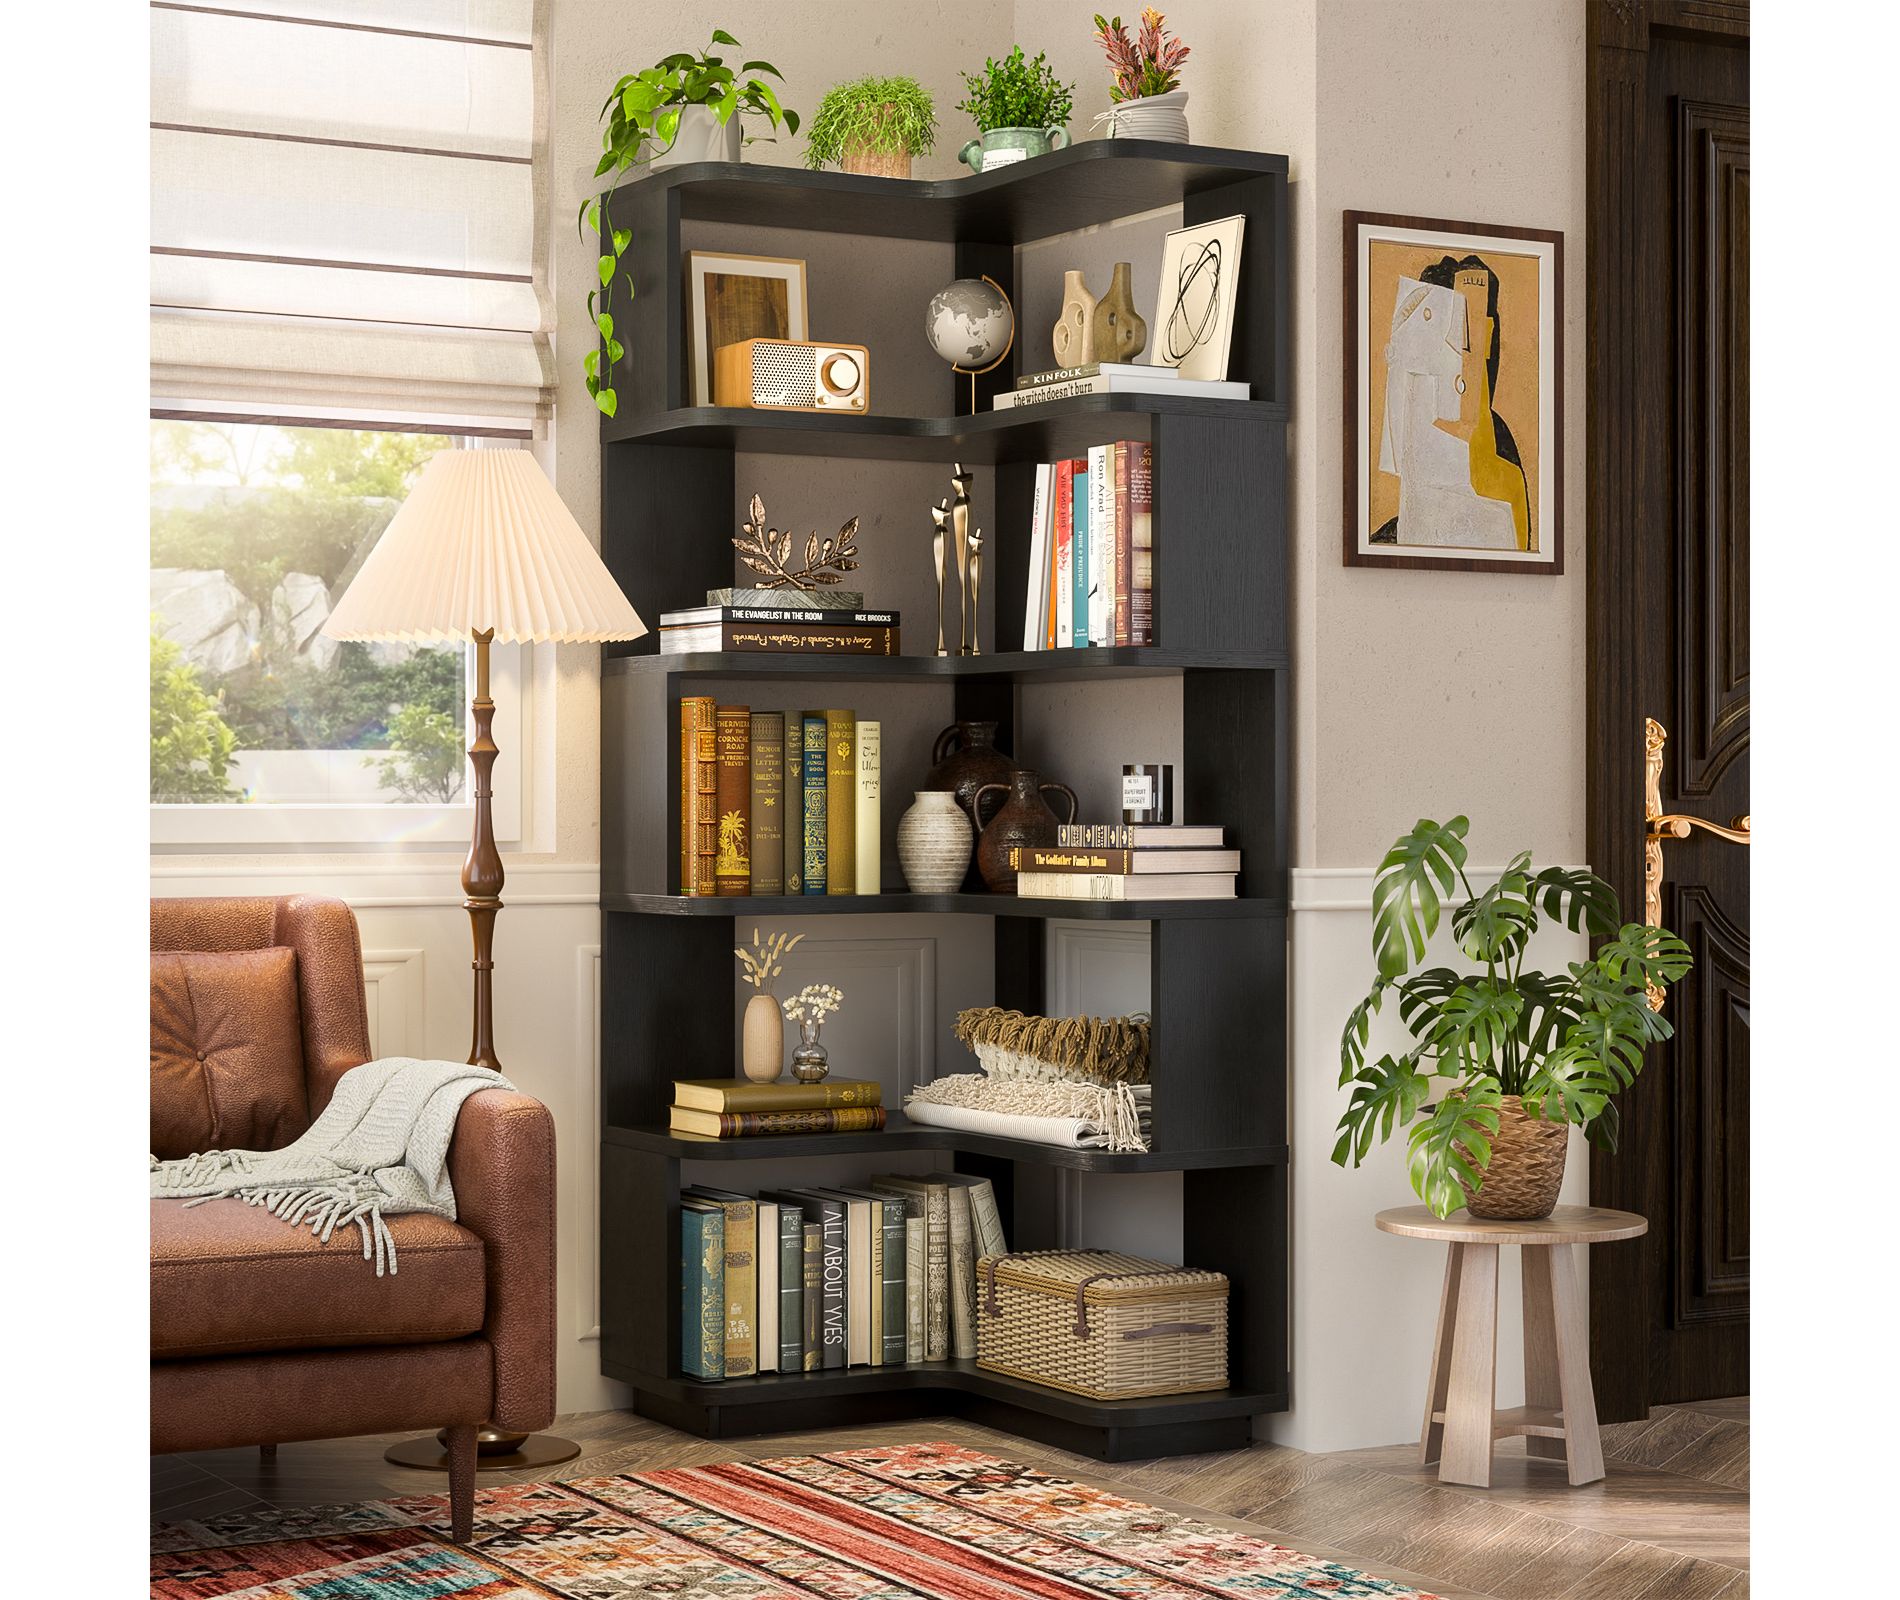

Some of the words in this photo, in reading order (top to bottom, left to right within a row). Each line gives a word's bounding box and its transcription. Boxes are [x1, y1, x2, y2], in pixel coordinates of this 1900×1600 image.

[1033, 368, 1082, 384] KINFOLK
[1074, 381, 1093, 394] burn
[1106, 533, 1114, 566] DAYS
[731, 609, 744, 619] THE
[745, 610, 783, 620] EVANGELIST
[783, 611, 791, 620] IN
[791, 611, 804, 620] THE
[804, 611, 823, 621] ROOM
[1035, 854, 1045, 865] The
[1046, 854, 1071, 866] Godfather
[1072, 855, 1090, 868] Family
[823, 1209, 843, 1238] ALL
[823, 1243, 843, 1299] ABOUT
[823, 1305, 843, 1345] YVES
